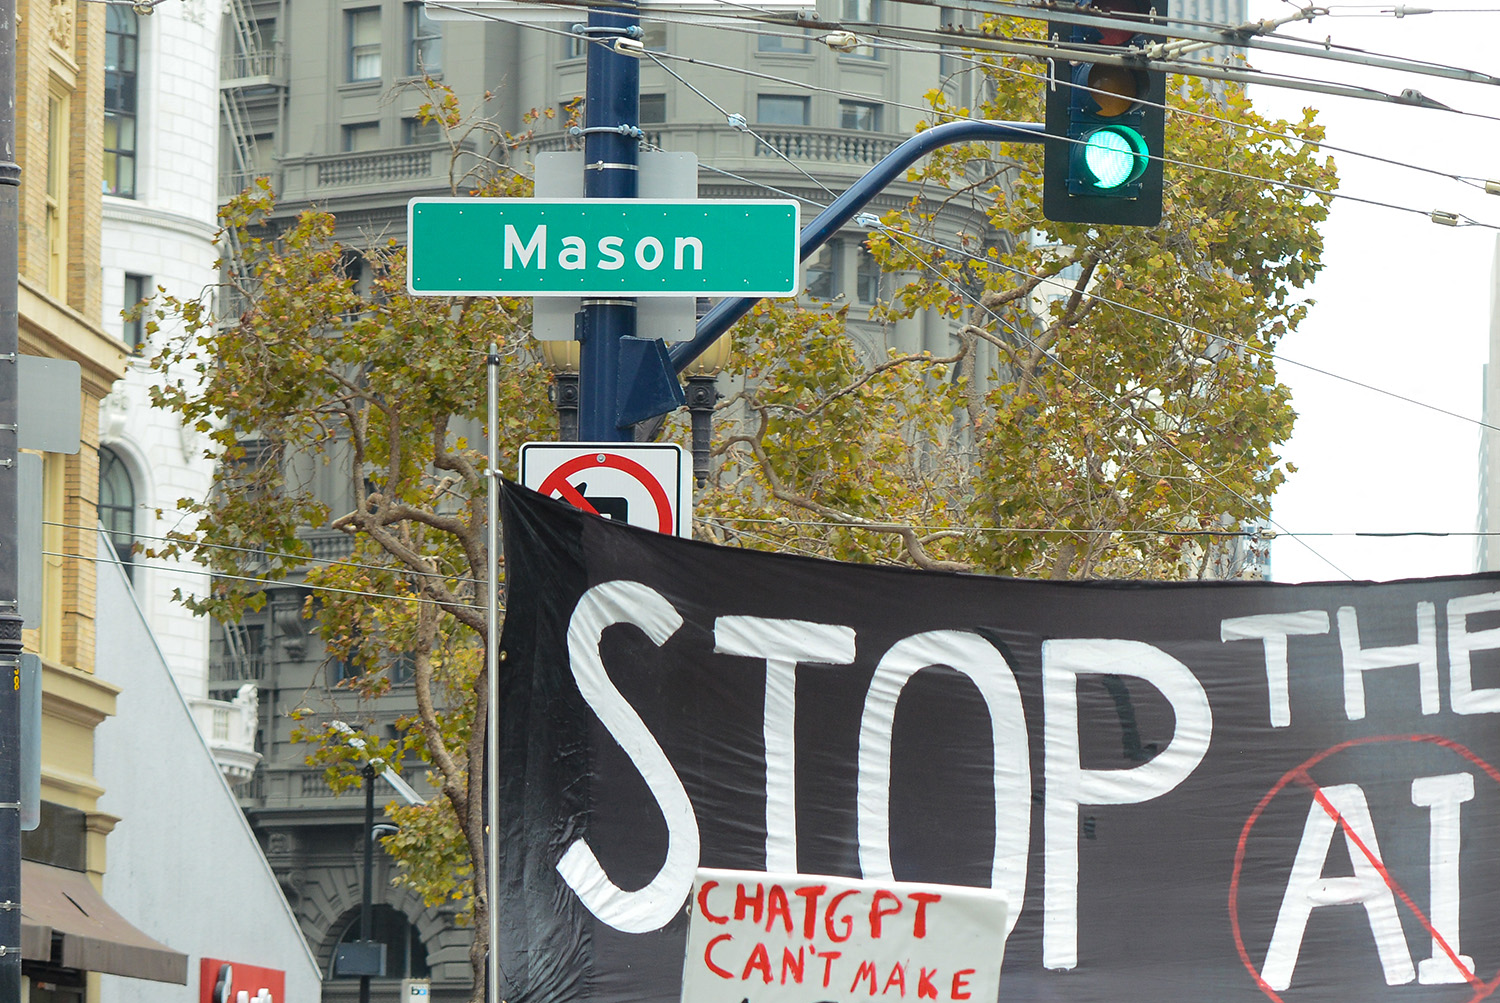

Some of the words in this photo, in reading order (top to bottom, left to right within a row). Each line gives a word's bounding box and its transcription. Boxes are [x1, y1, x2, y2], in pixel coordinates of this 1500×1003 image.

[504, 223, 703, 271] Mason
[555, 580, 1213, 971] STOP
[698, 880, 942, 943] CHATGPT
[1260, 771, 1475, 991] AI
[704, 933, 842, 988] CAN'T
[850, 958, 976, 1001] MAKE
